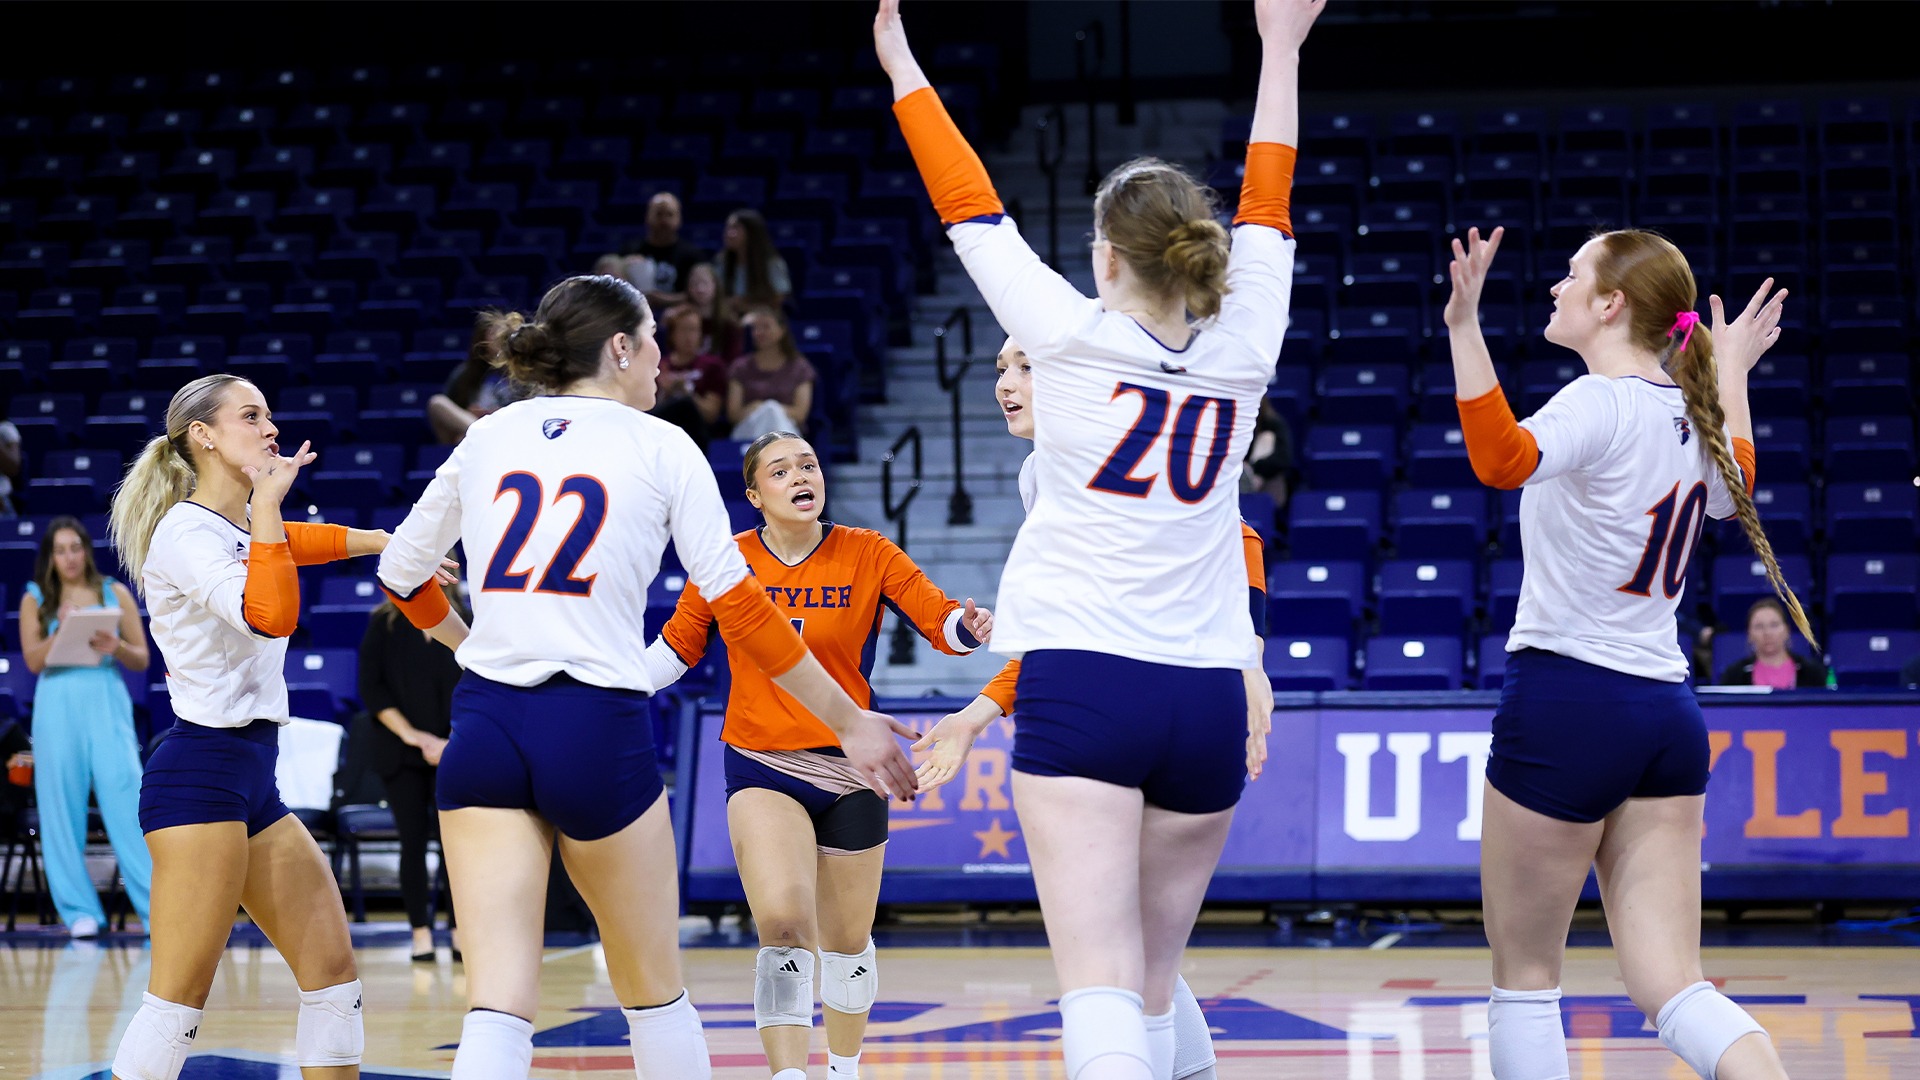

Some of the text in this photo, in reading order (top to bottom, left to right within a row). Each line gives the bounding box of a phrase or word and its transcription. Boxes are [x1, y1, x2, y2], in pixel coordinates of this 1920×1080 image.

[1087, 381, 1236, 504] 20
[481, 470, 609, 597] 22
[1616, 480, 1708, 599] 10
[765, 585, 851, 609] TYLER
[1337, 732, 1493, 841] UT
